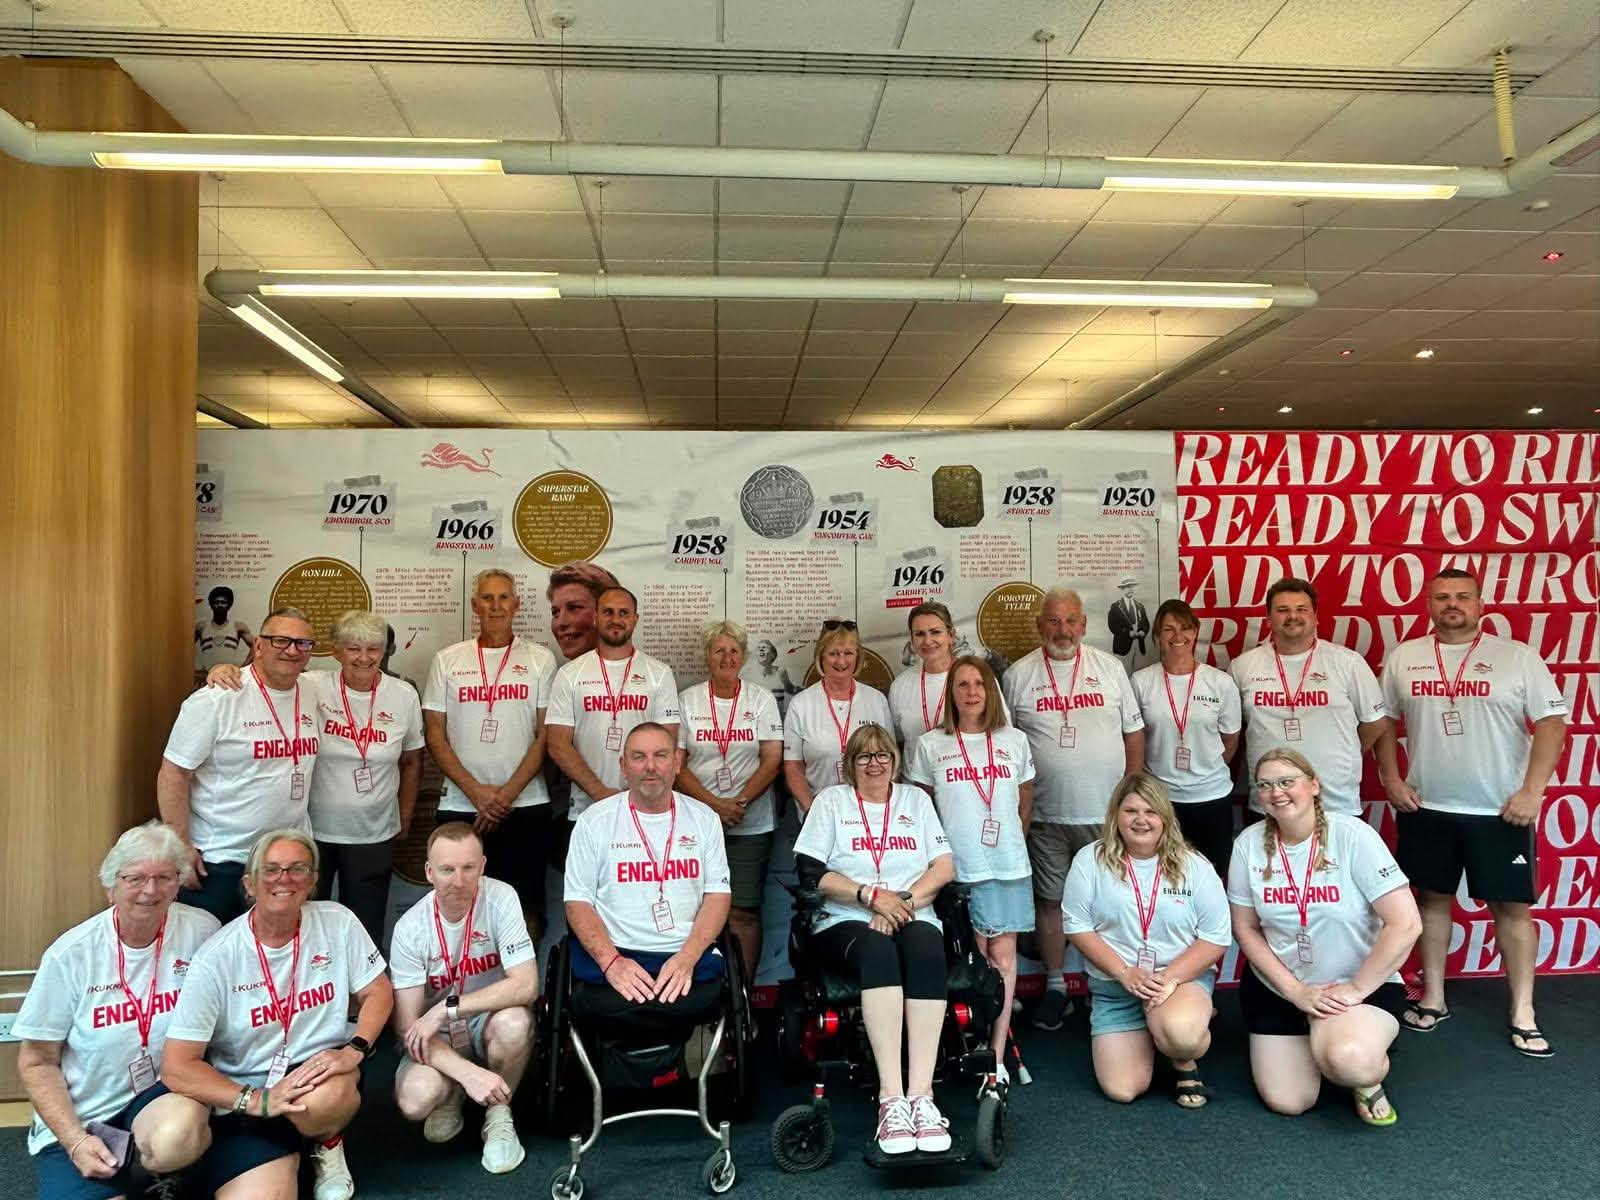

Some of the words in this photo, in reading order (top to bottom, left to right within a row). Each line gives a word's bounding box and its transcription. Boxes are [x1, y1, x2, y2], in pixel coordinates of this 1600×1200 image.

[1177, 434, 1400, 486] READY
[1410, 433, 1495, 487] TO
[538, 485, 590, 493] SUPERSTAR
[552, 494, 576, 502] RAND
[1002, 486, 1056, 506] 1938
[1102, 487, 1155, 508] 1930
[329, 493, 388, 515] 1970
[437, 518, 495, 540] 1966
[817, 510, 871, 530] 1954
[1178, 494, 1391, 547] READY
[1400, 493, 1485, 546] TO
[672, 534, 728, 556] 1958
[301, 569, 320, 577] RON
[321, 569, 342, 577] HILL
[892, 563, 945, 588] 1946
[1338, 553, 1425, 607] TO
[998, 594, 1037, 602] DOROTHY
[458, 684, 529, 703] ENGLAND
[1411, 680, 1490, 697] ENGLAND
[584, 694, 648, 712] ENGLAND
[1036, 693, 1105, 712] ENGLAND
[1254, 691, 1329, 707] ENGLAND
[248, 720, 272, 728] KUKRI
[696, 728, 754, 742] ENGLAND
[253, 736, 319, 760] ENGLAND
[945, 764, 1012, 783] ENGLAND
[852, 836, 918, 852] ENGLAND
[617, 858, 699, 883] ENGLAND
[238, 980, 267, 993] KUKR
[93, 988, 182, 1030] ENGLAN
[250, 981, 335, 1028] ENGLAND
